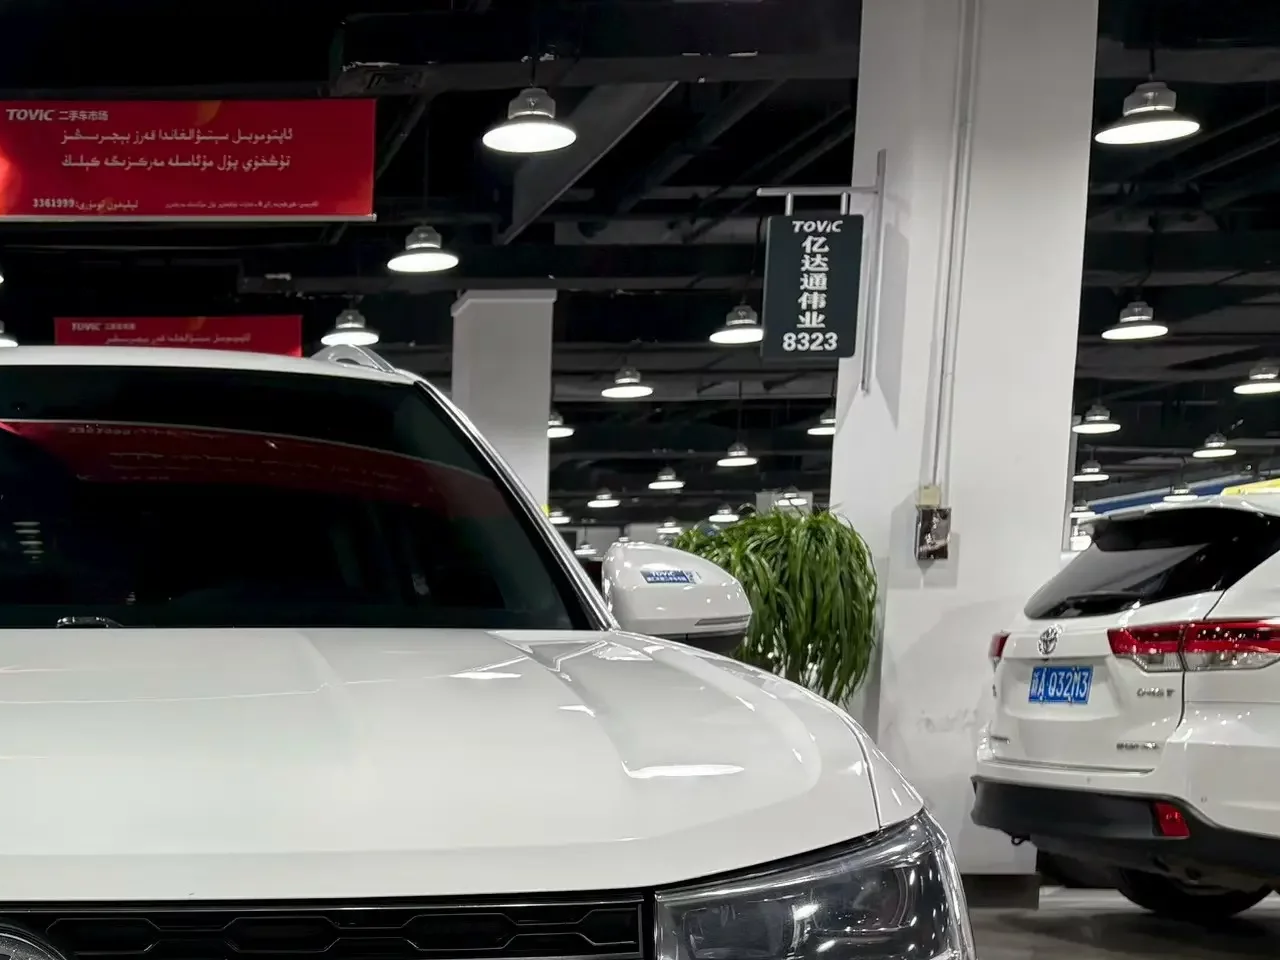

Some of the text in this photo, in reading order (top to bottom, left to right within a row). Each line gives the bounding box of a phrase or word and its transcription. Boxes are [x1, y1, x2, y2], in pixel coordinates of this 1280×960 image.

[5, 108, 55, 121] TOVIC
[792, 220, 844, 233] TOVIC
[796, 235, 830, 329] 亿达通伟业
[782, 332, 839, 351] 8323
